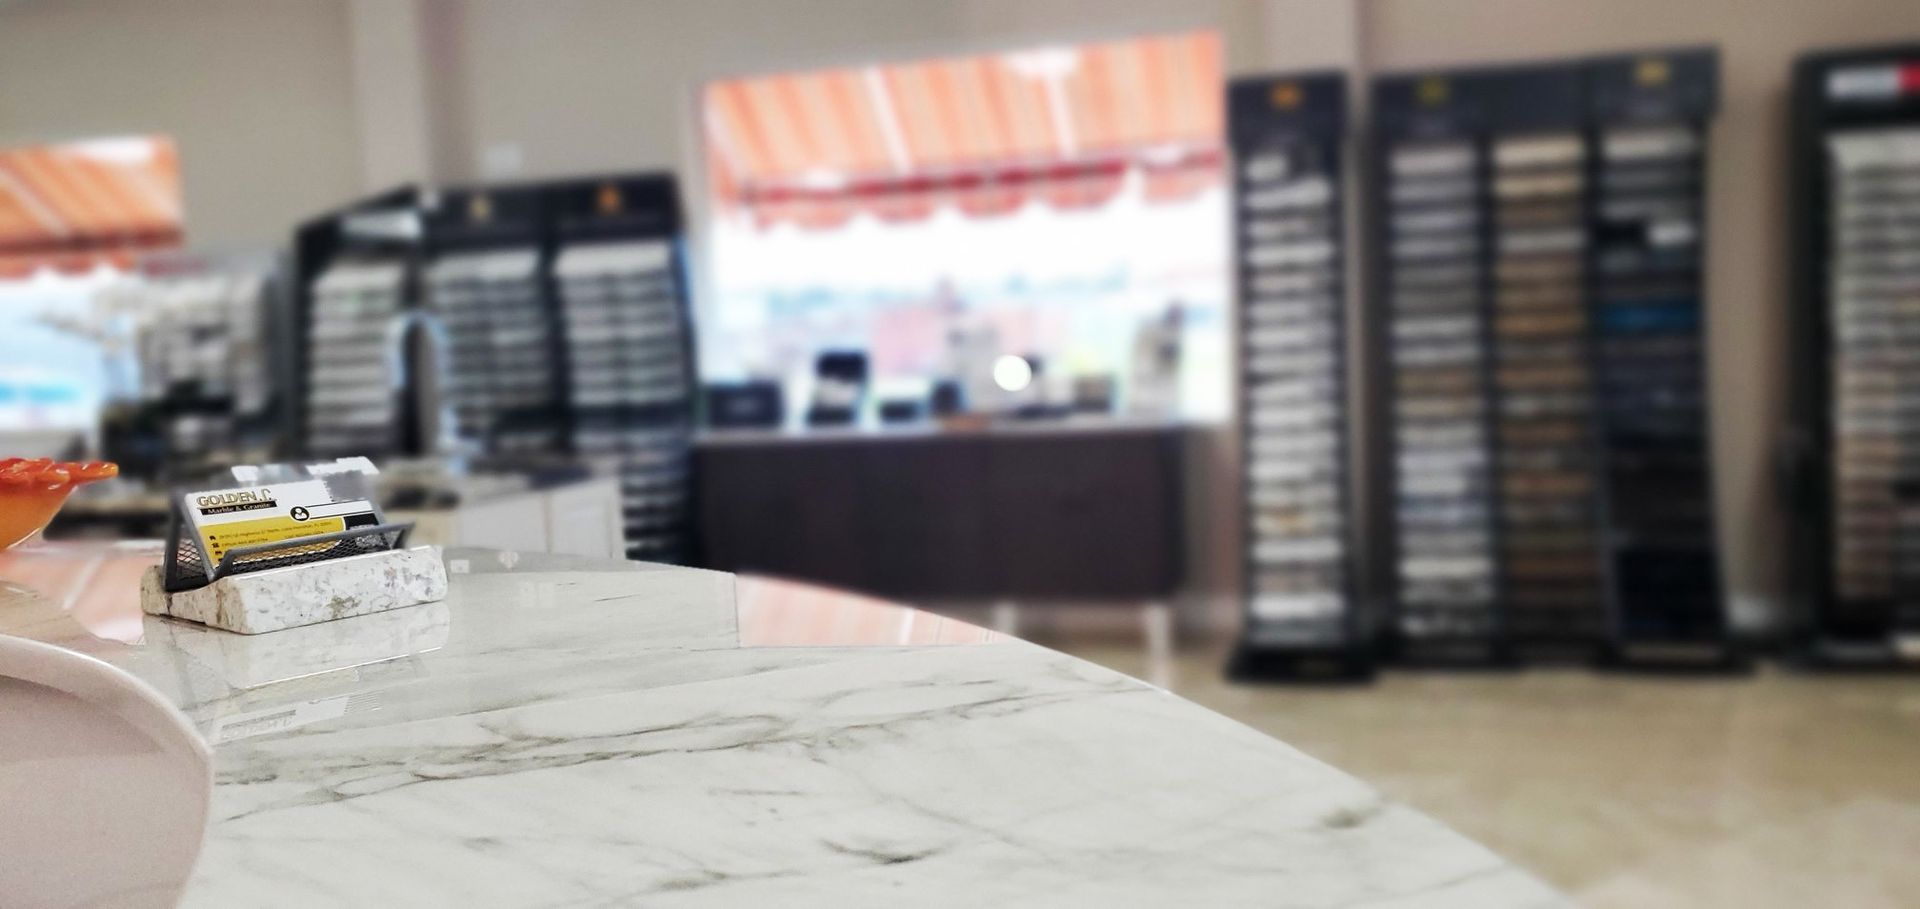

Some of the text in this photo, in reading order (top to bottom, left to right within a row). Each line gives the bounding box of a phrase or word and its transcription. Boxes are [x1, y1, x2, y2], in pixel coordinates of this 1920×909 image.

[197, 492, 257, 506] GOLDEN
[207, 506, 234, 514] Marble
[243, 502, 271, 510] Granite
